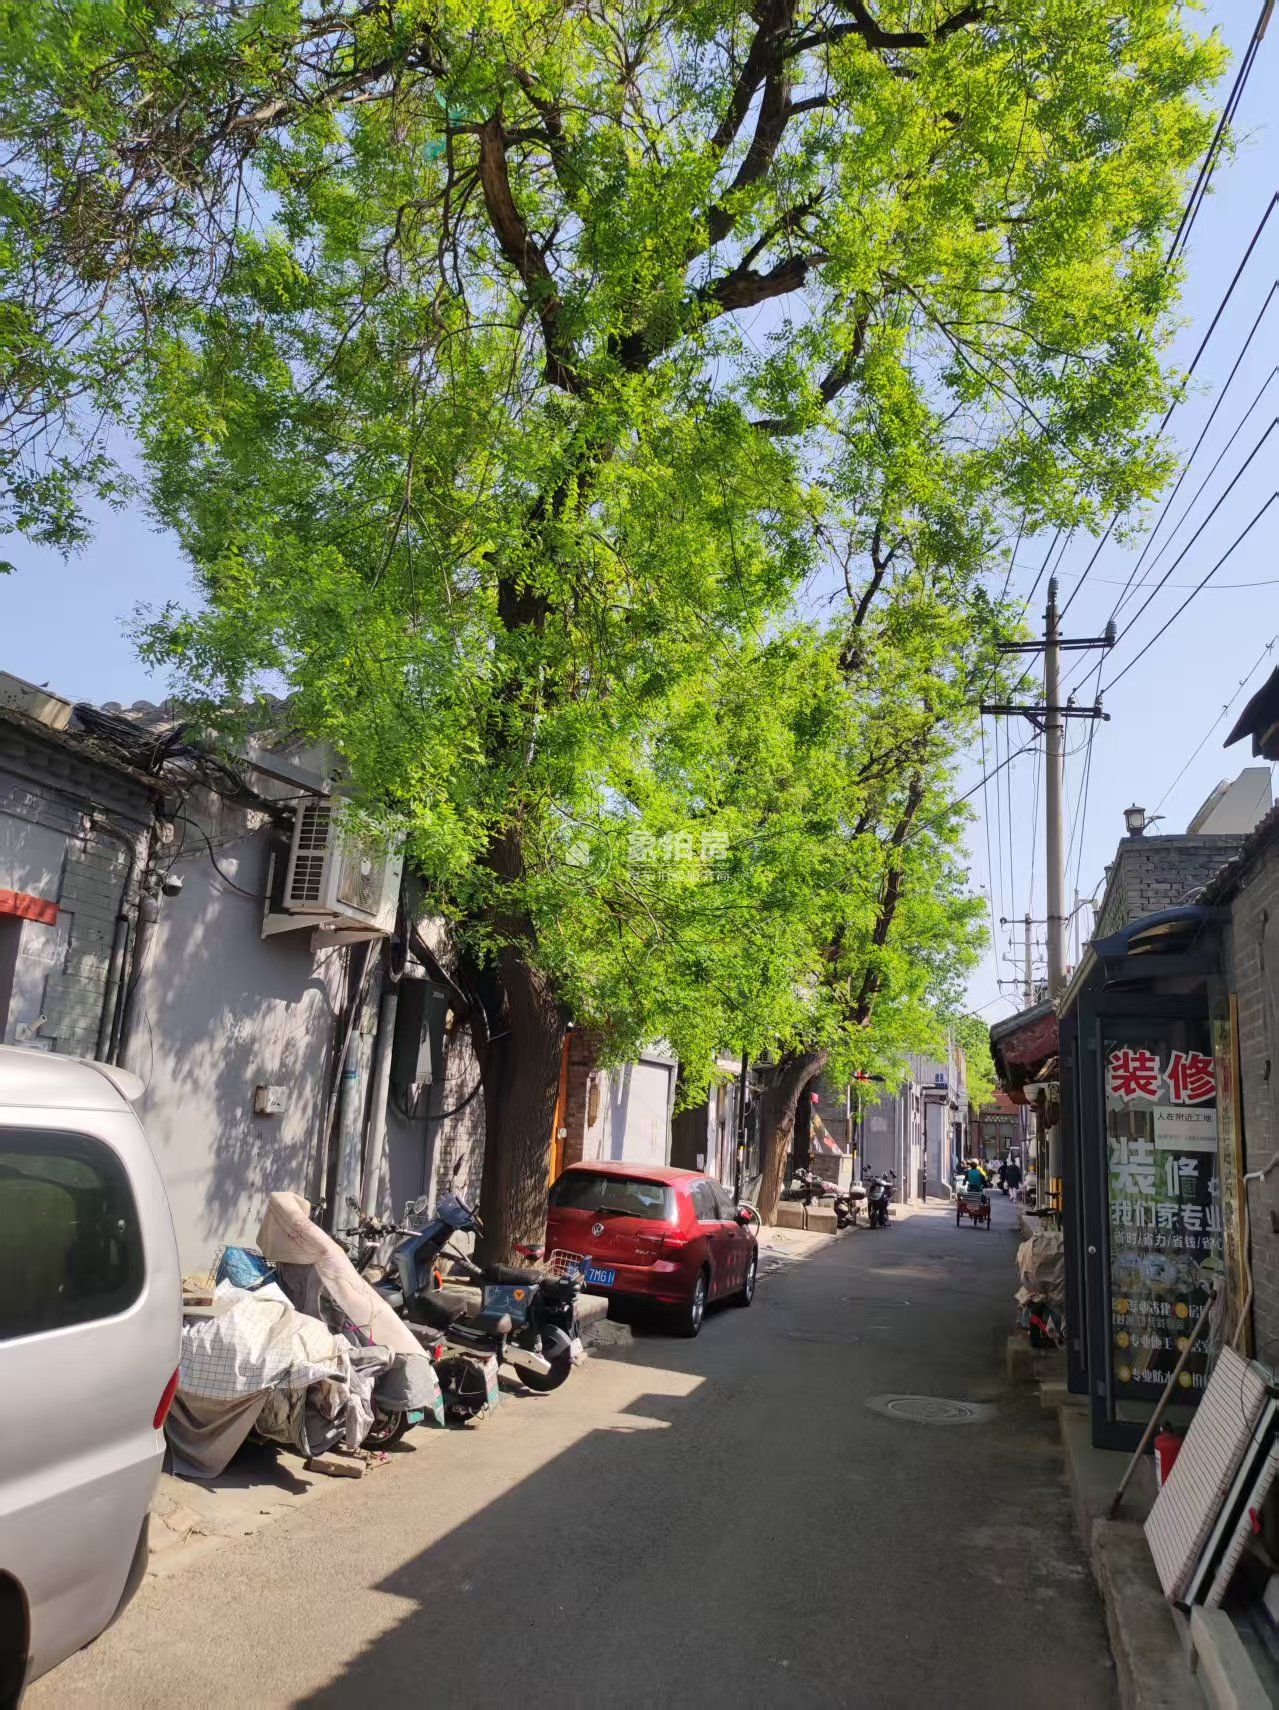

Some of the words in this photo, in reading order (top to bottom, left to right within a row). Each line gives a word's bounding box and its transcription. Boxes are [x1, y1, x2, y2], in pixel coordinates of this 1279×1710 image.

[1109, 1050, 1216, 1103] 装修
[1157, 1112, 1213, 1123] 人在附近工地
[1112, 1199, 1223, 1231] 我们家专业
